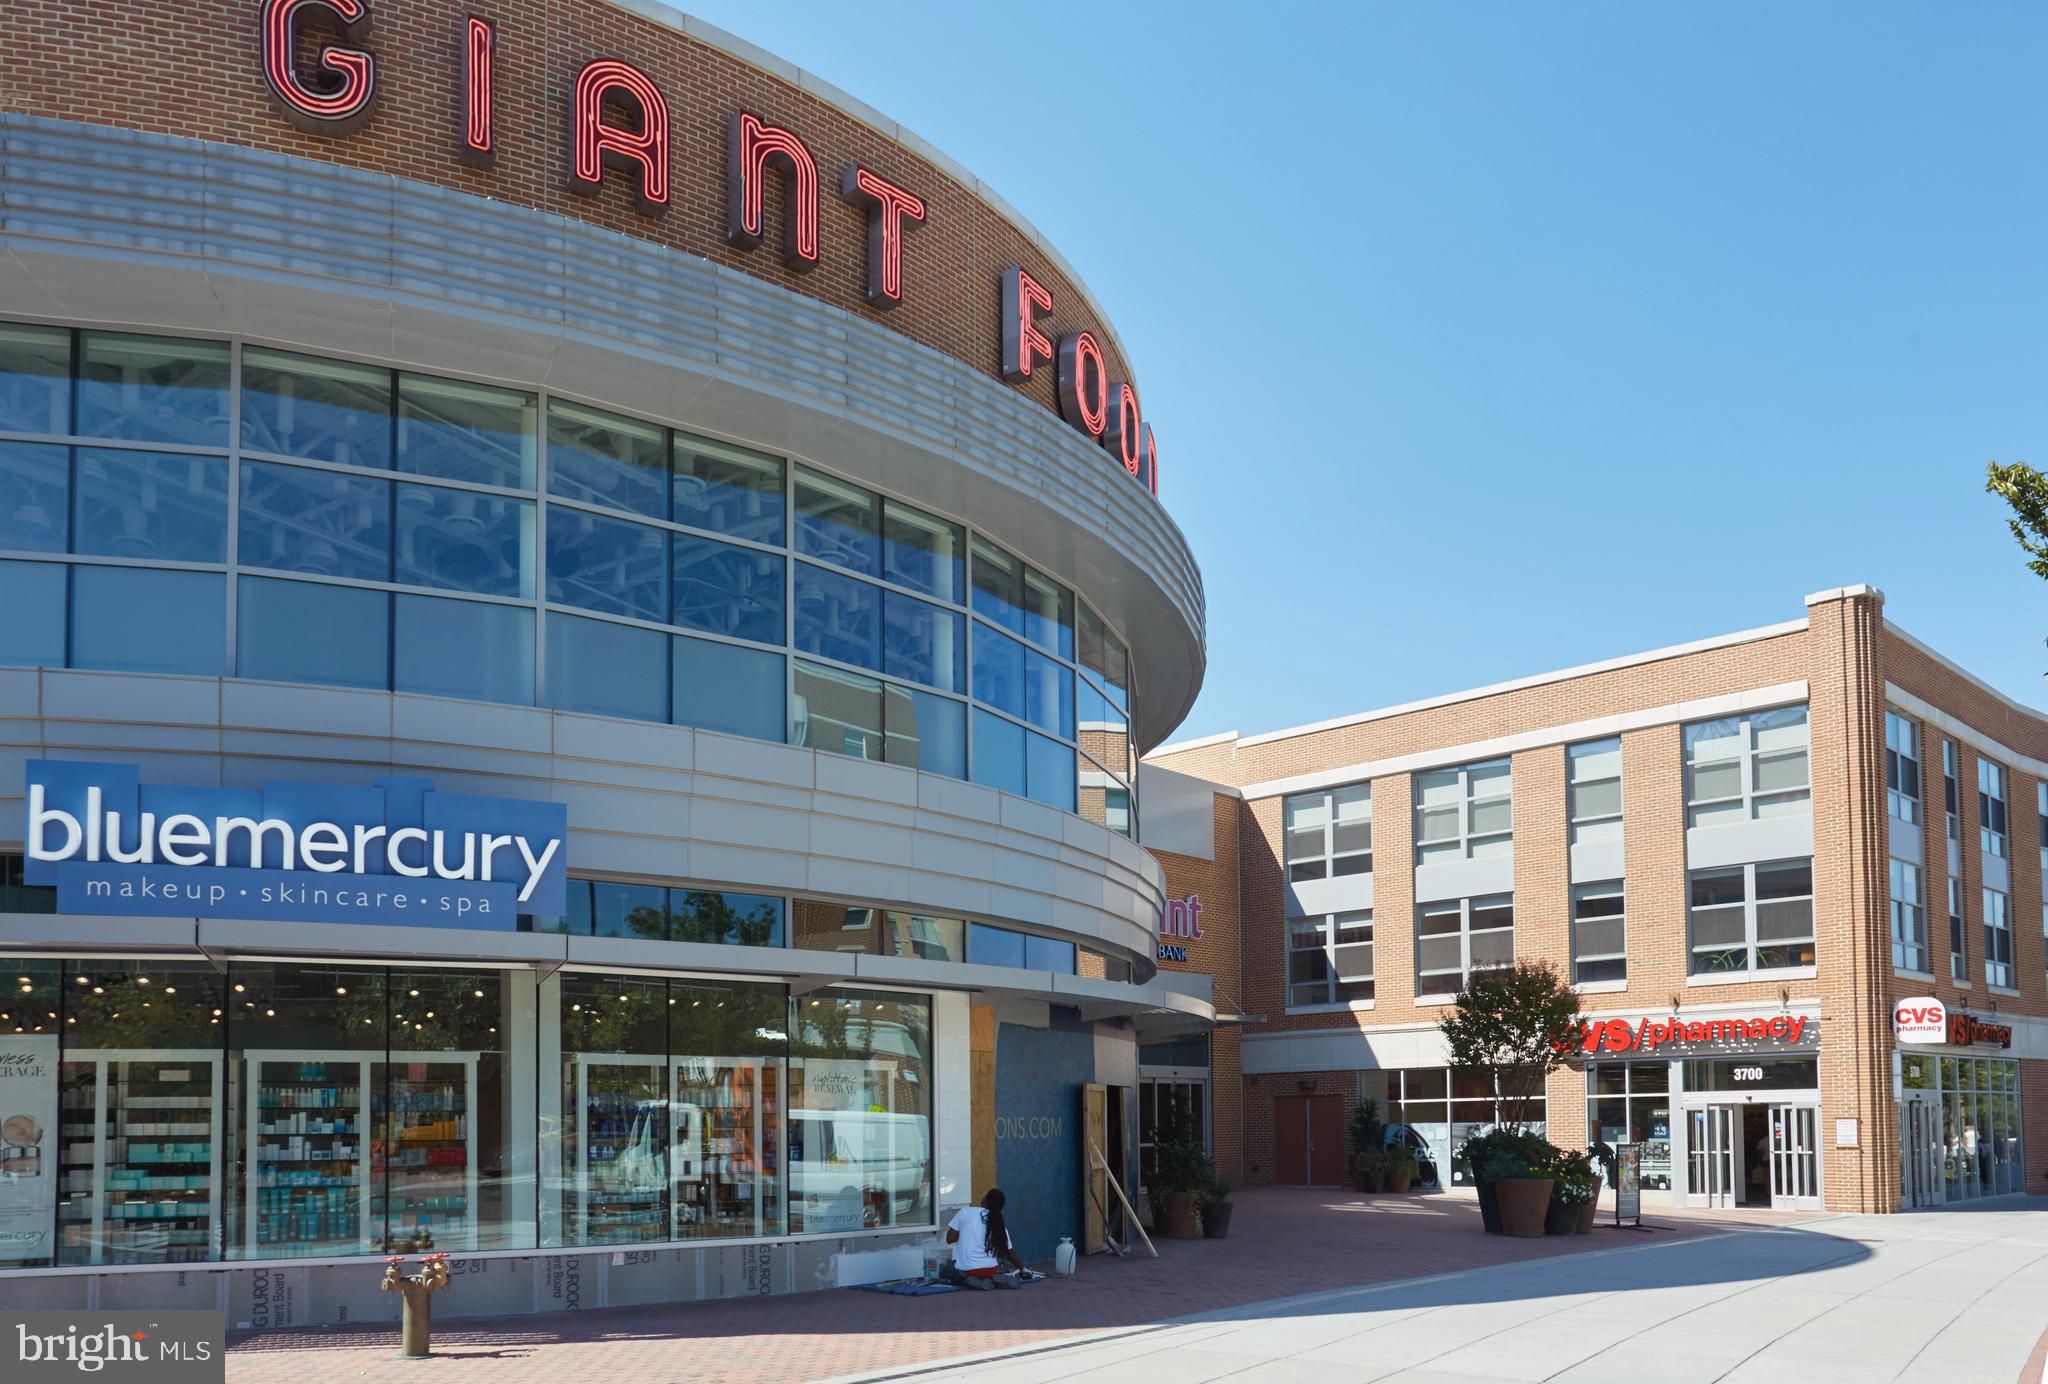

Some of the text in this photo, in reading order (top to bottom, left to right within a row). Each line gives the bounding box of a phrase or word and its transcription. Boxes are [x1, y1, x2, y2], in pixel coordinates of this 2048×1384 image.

[28, 783, 561, 902] bluemercury
[87, 877, 492, 917] makeup skincare spa
[1159, 944, 1187, 960] BANK
[1895, 1007, 1943, 1025] CVS
[1896, 1024, 1942, 1033] pharmacy
[1733, 1068, 1763, 1081] 3700
